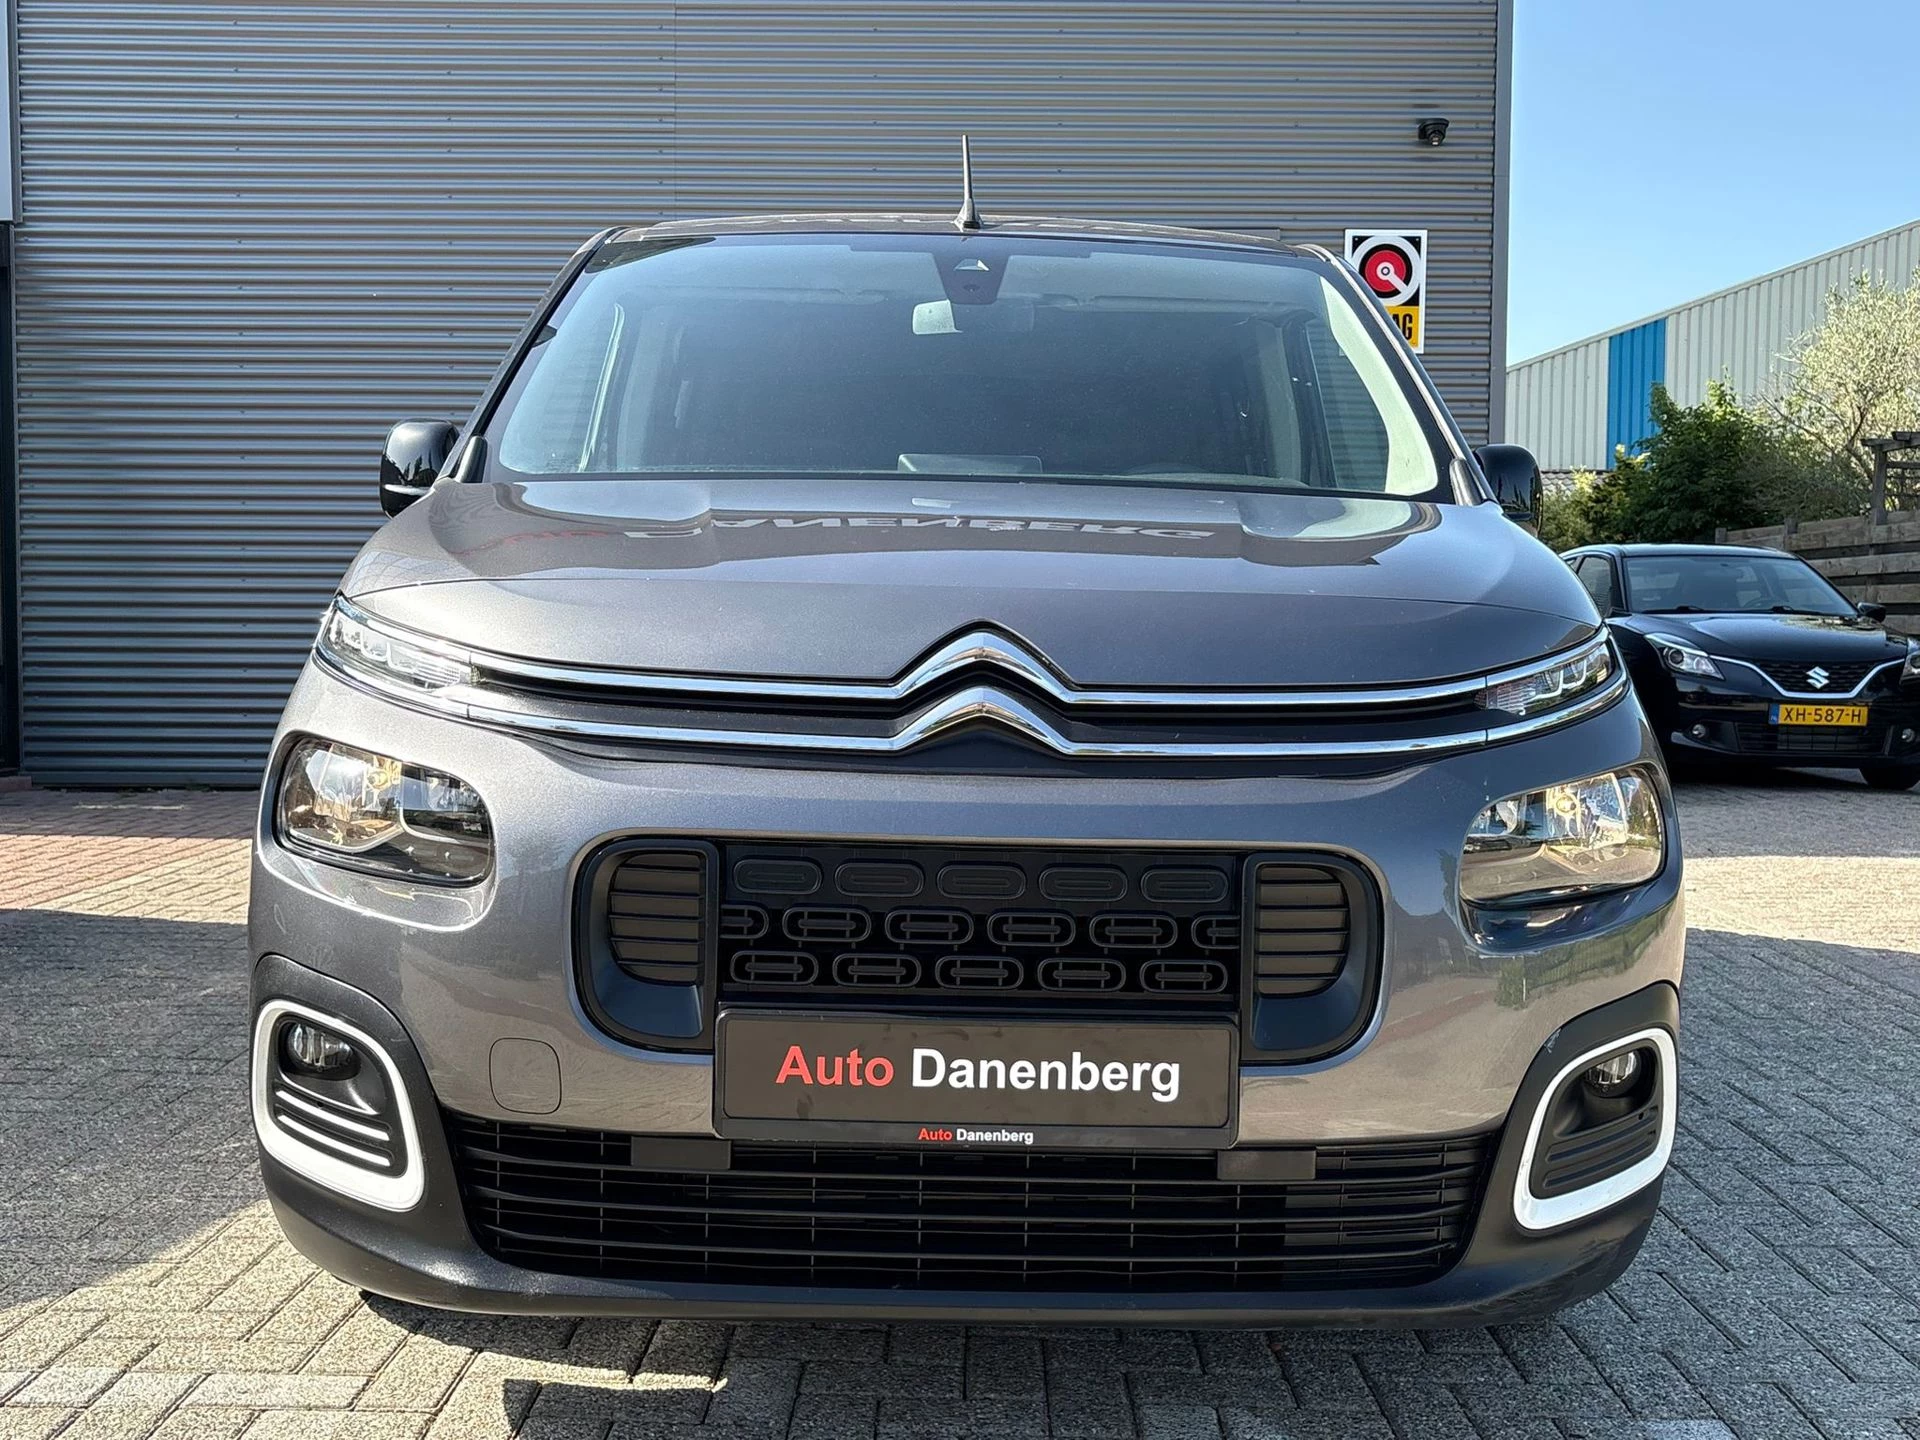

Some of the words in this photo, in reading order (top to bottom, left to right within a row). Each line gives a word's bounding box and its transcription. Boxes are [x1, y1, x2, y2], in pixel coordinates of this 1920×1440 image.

[1784, 707, 1861, 723] XH-587-H
[776, 1045, 894, 1087] Auto
[912, 1048, 1181, 1102] Danenberg
[918, 1128, 952, 1141] Auto
[956, 1128, 1034, 1145] Danenberg
